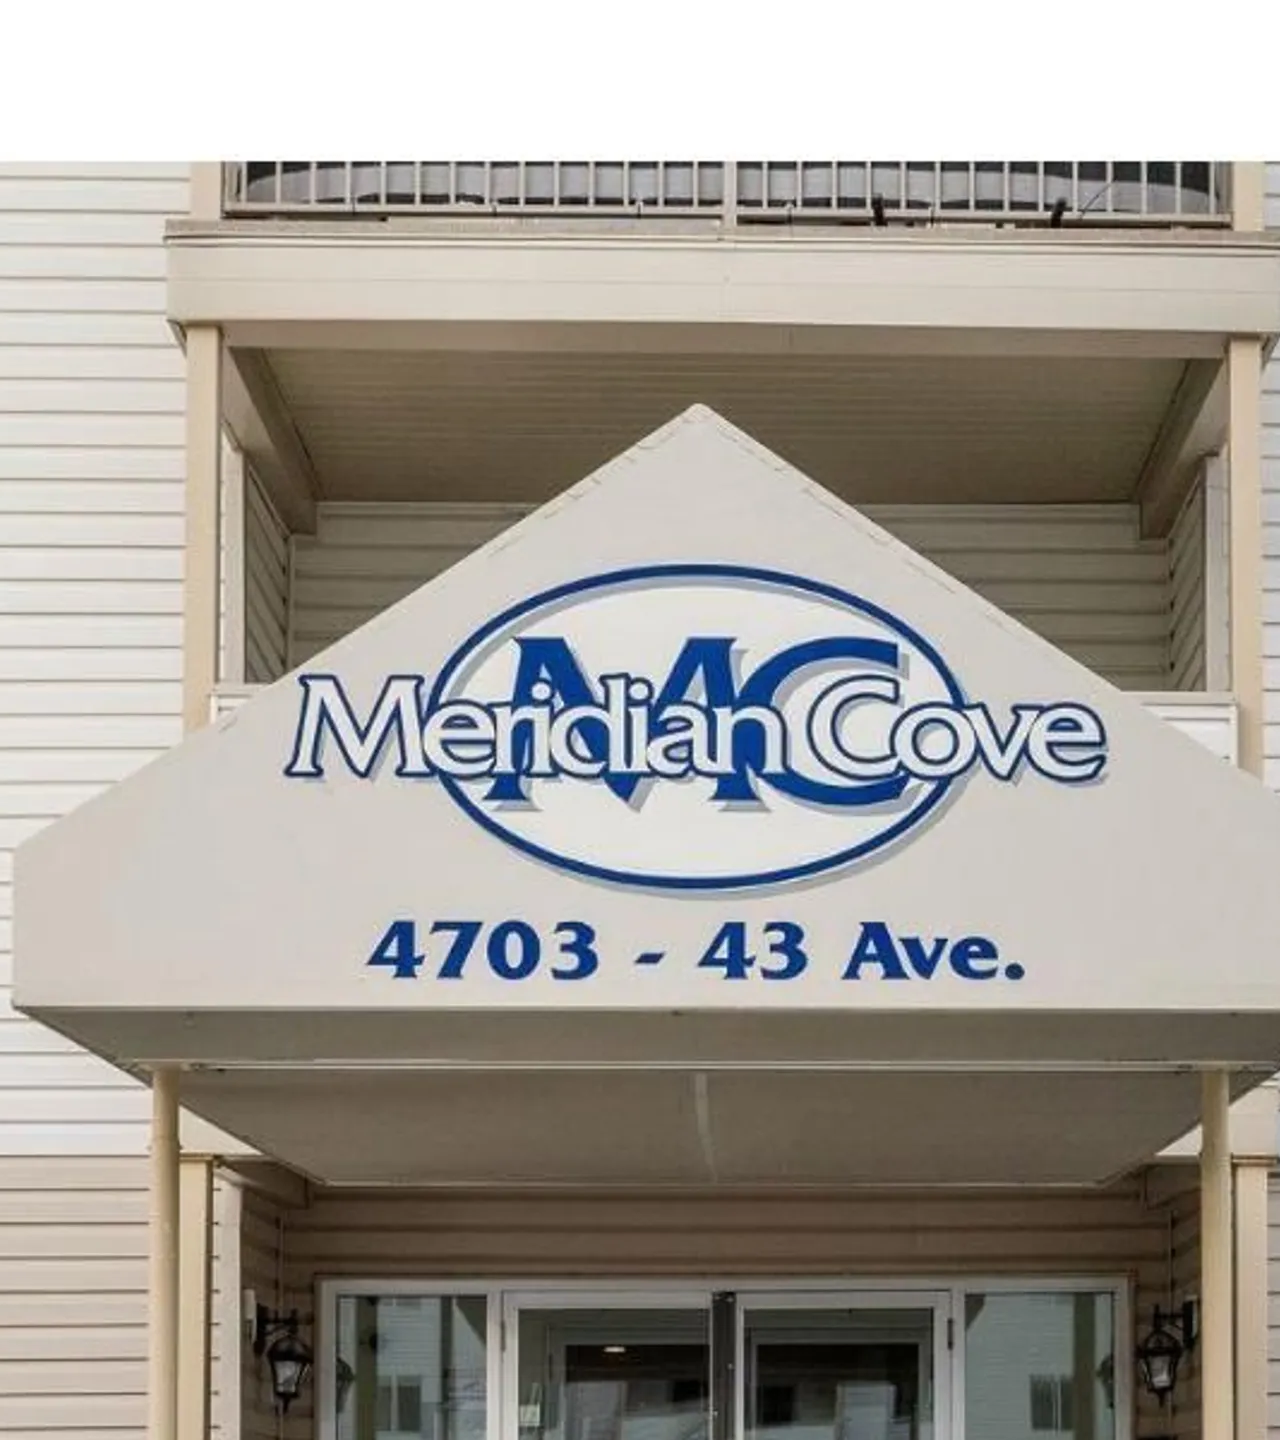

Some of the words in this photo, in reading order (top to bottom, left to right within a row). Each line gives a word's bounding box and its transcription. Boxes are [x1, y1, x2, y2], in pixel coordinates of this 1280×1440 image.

[283, 673, 787, 779] Meridian
[807, 674, 1107, 782] Cove
[482, 636, 909, 806] MC
[366, 919, 599, 981] 4703
[634, 951, 666, 965] -
[697, 921, 809, 981] 43
[840, 921, 1026, 981] Ave.
